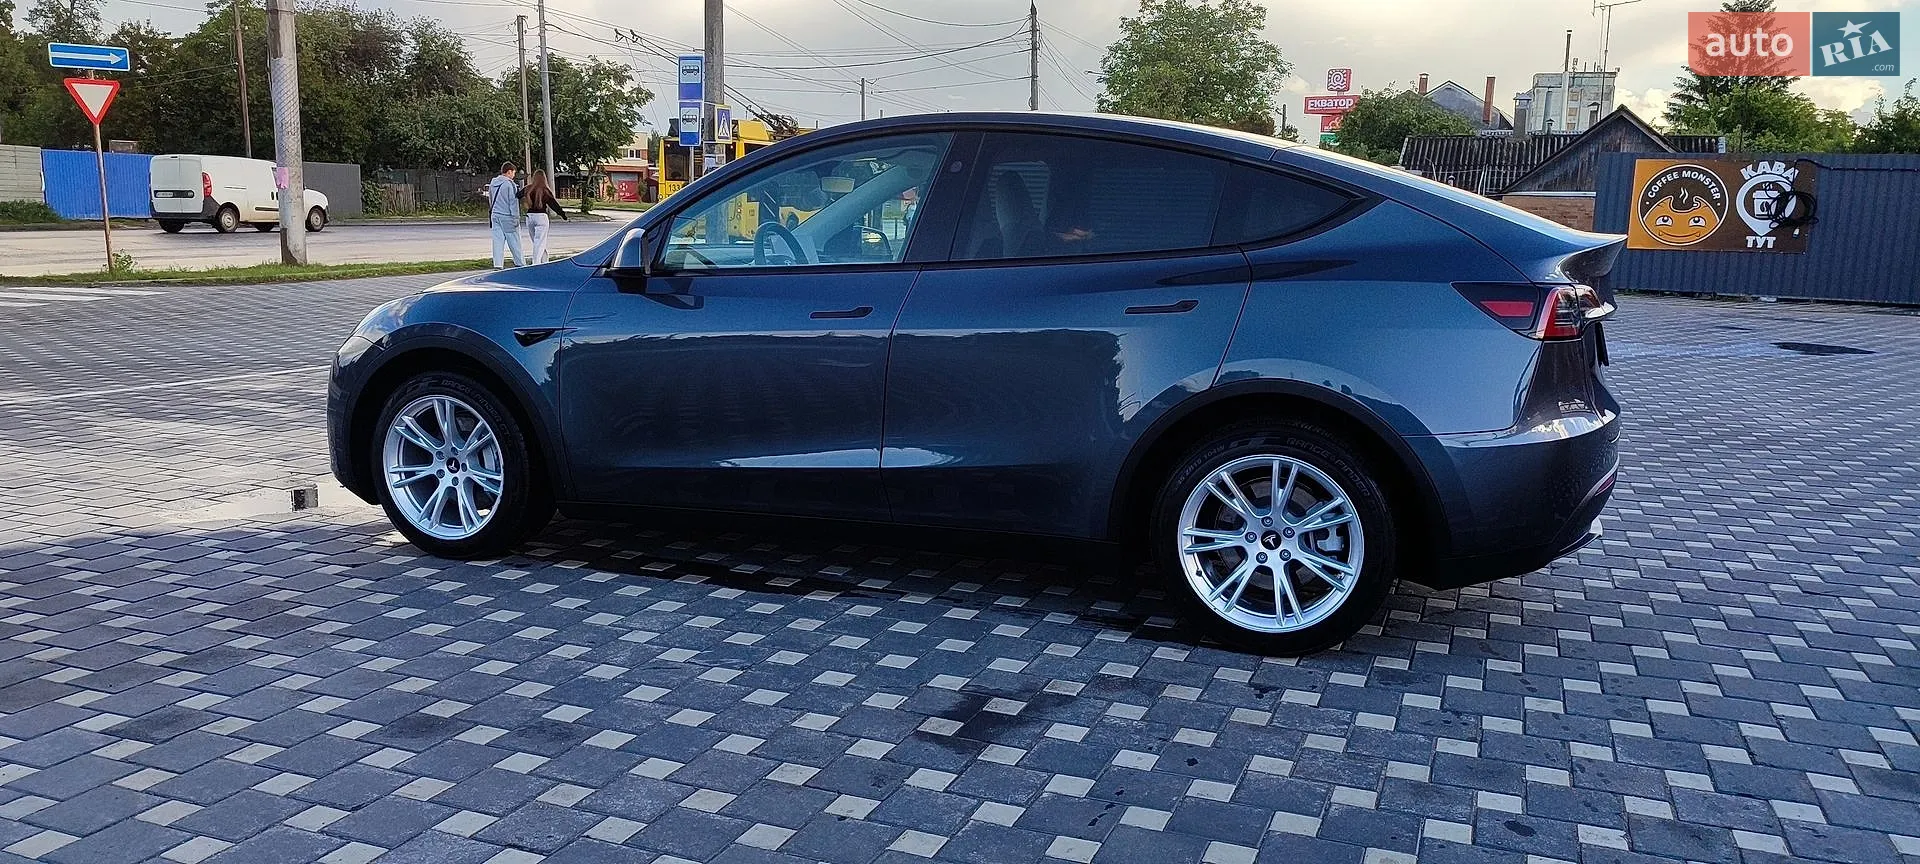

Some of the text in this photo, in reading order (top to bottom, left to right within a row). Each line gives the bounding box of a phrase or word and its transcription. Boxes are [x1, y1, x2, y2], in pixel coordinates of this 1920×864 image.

[1740, 161, 1799, 181] КАВА
[1647, 170, 1721, 200] COFFEE MONSTER
[1745, 236, 1777, 249] ТУТ
